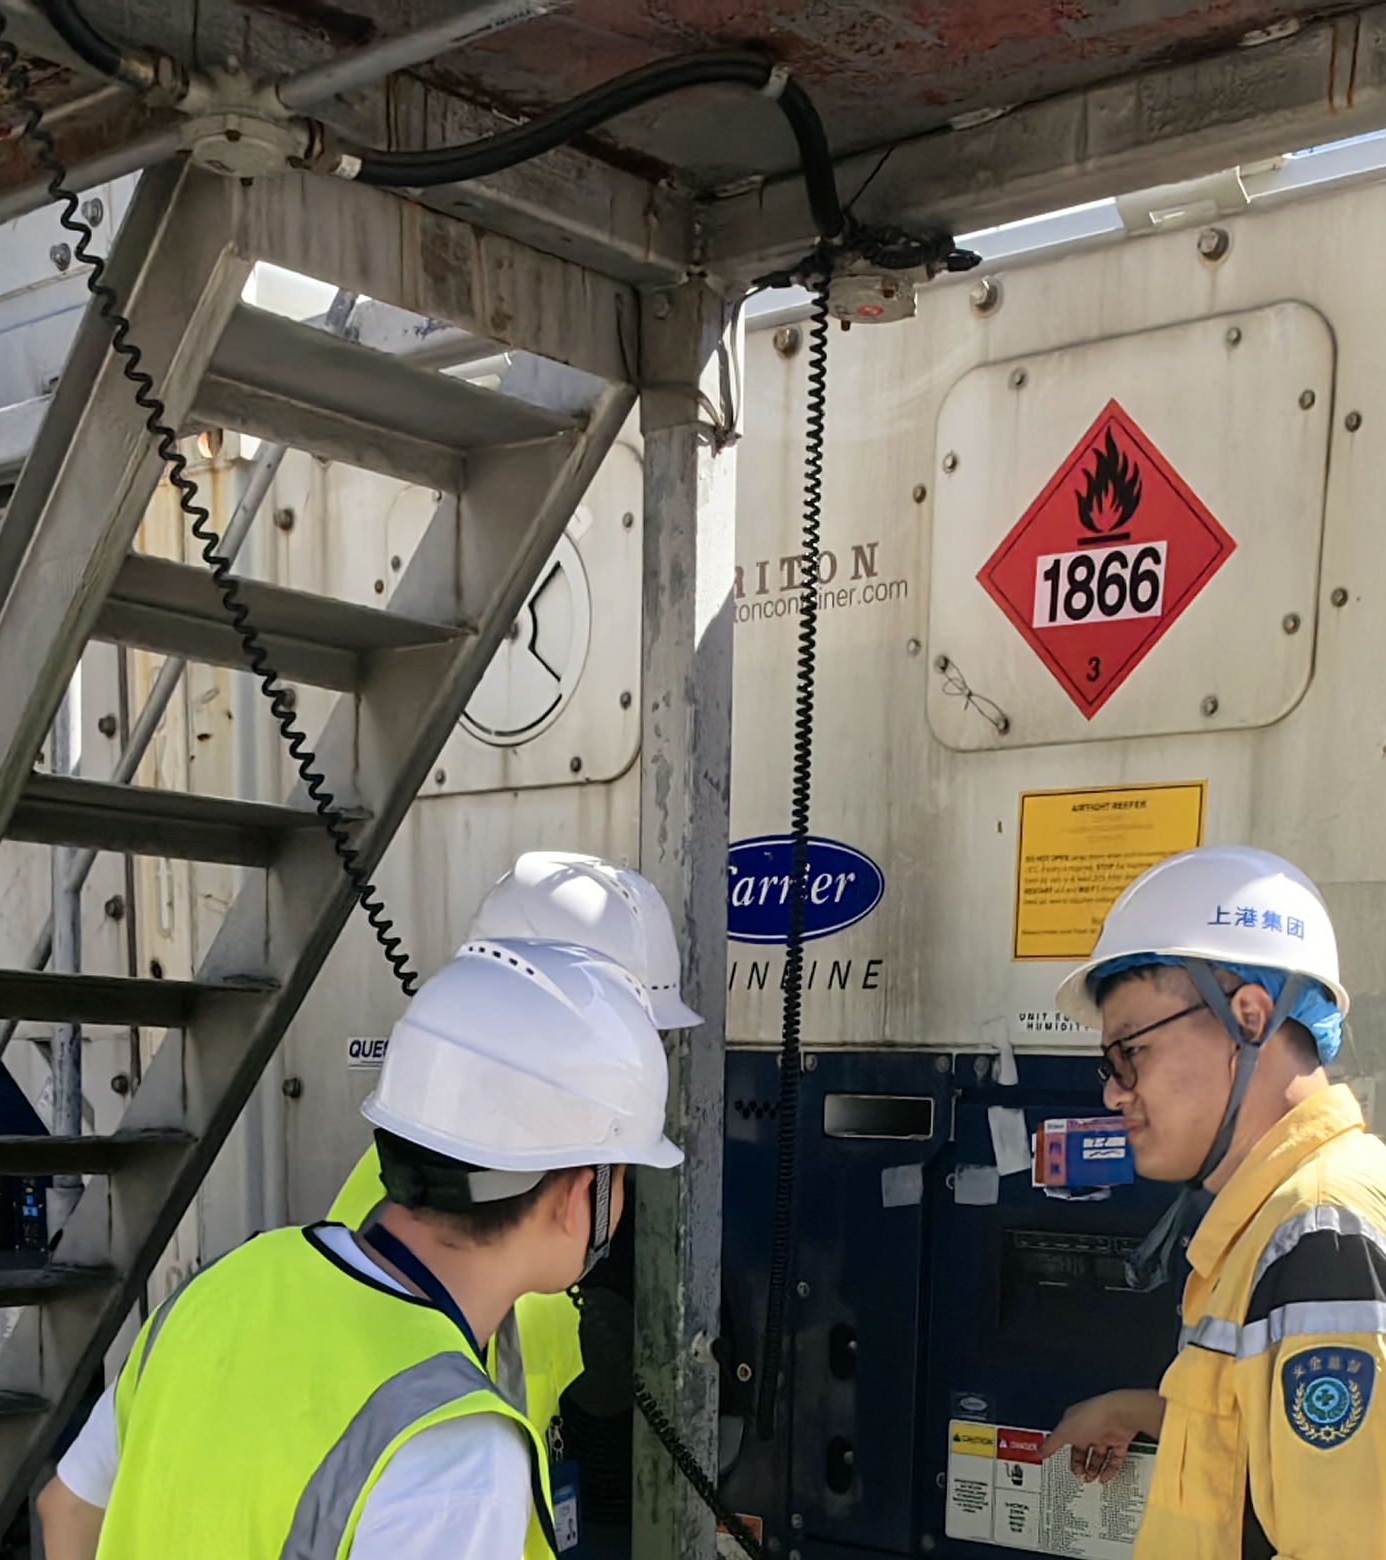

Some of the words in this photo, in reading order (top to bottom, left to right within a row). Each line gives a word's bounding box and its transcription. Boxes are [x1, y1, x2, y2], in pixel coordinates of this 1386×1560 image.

[1043, 546, 1162, 623] 1866
[1086, 656, 1101, 682] 3
[1207, 905, 1304, 940] 上港集团
